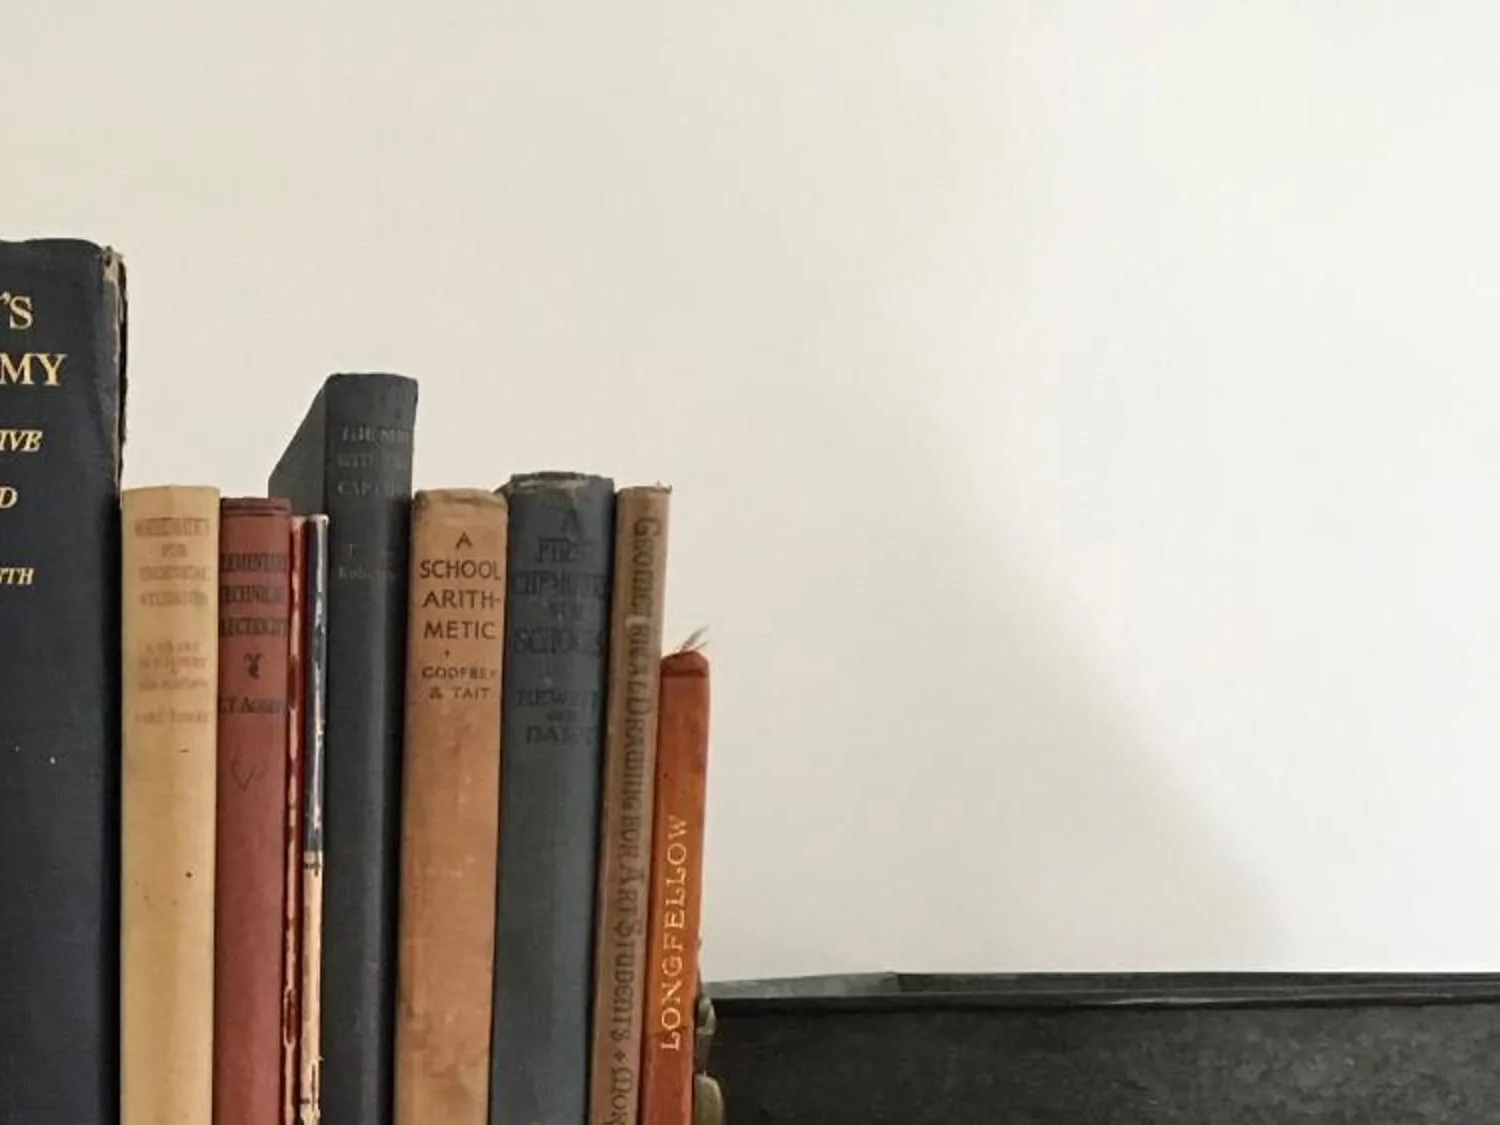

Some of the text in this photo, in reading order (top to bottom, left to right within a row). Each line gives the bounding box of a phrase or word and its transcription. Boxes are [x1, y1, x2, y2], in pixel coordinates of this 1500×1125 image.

[456, 532, 472, 549] A
[419, 559, 502, 580] SCHOOL
[421, 589, 501, 609] ARITH-
[423, 620, 496, 640] METIC
[452, 686, 493, 700] TAIT
[660, 815, 691, 1051] LONGFELLOW
